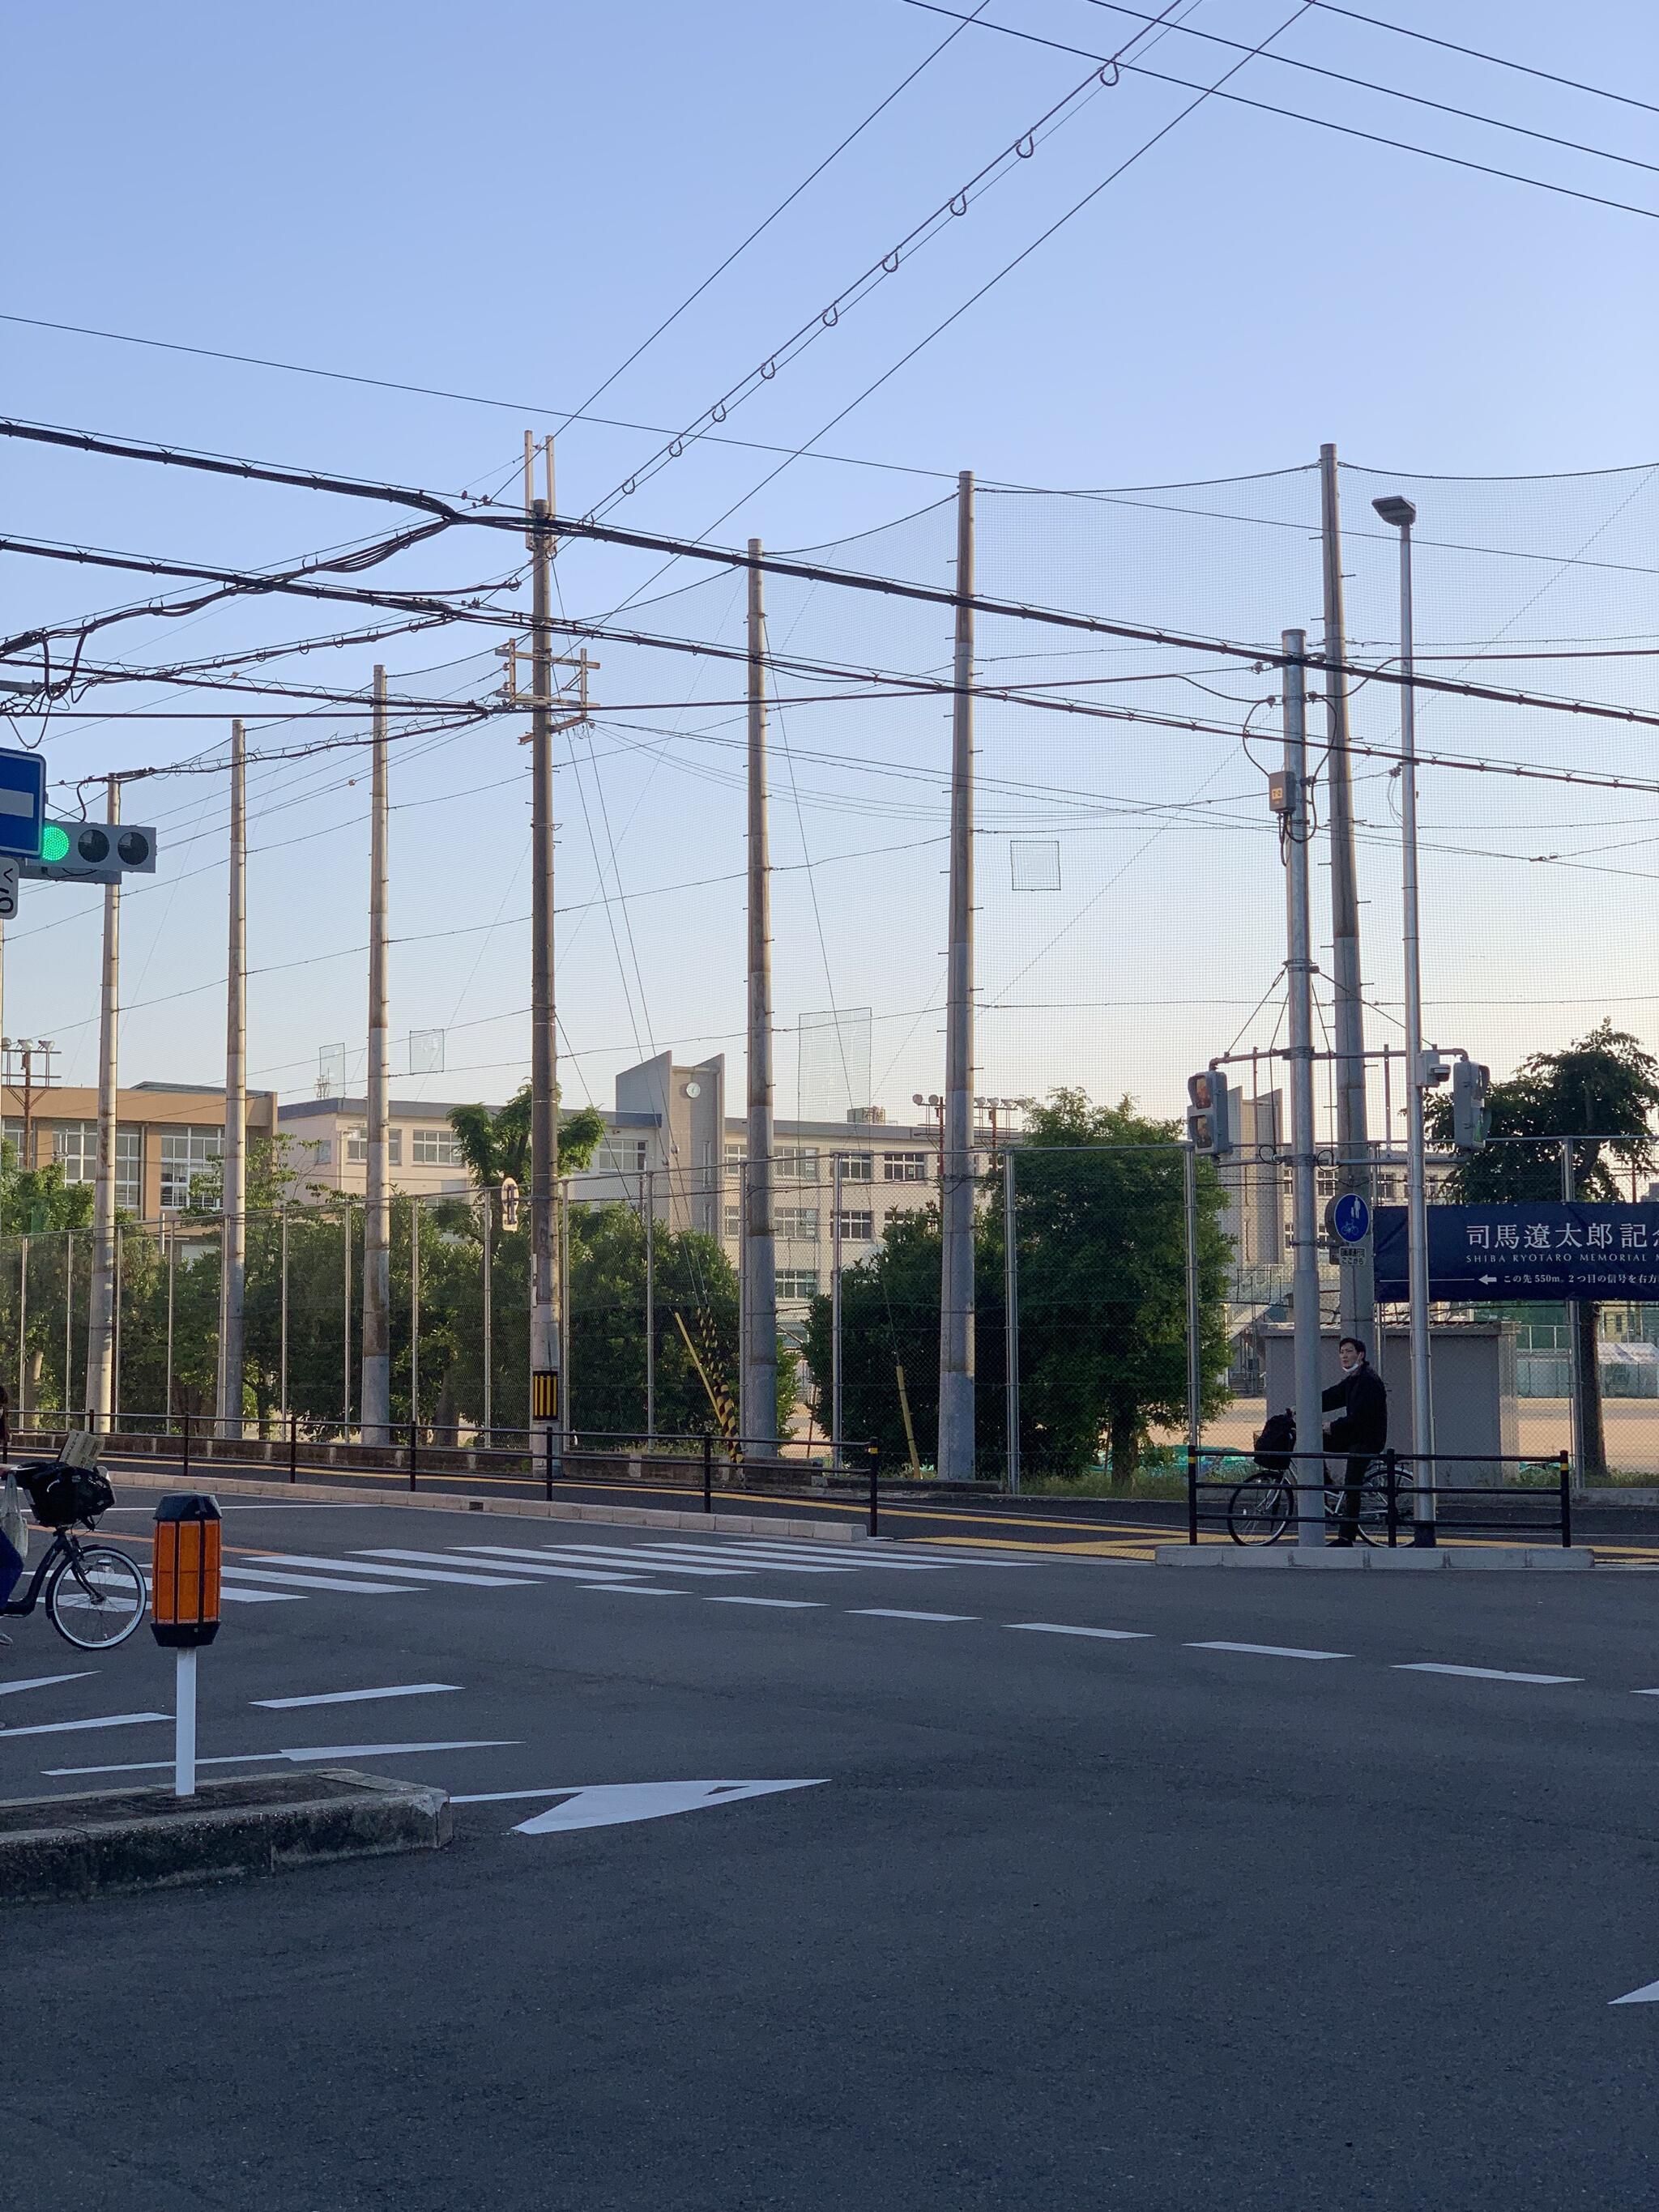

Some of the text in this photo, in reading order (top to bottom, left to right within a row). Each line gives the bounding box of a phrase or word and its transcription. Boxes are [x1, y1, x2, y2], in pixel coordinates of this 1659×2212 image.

[1465, 1255, 1506, 1264] SHIBA
[1512, 1253, 1572, 1263] RYOTARO
[1580, 1253, 1647, 1262] MEMORIAL
[1503, 1274, 1659, 1284] この先550m。2つ目の信号を右方
